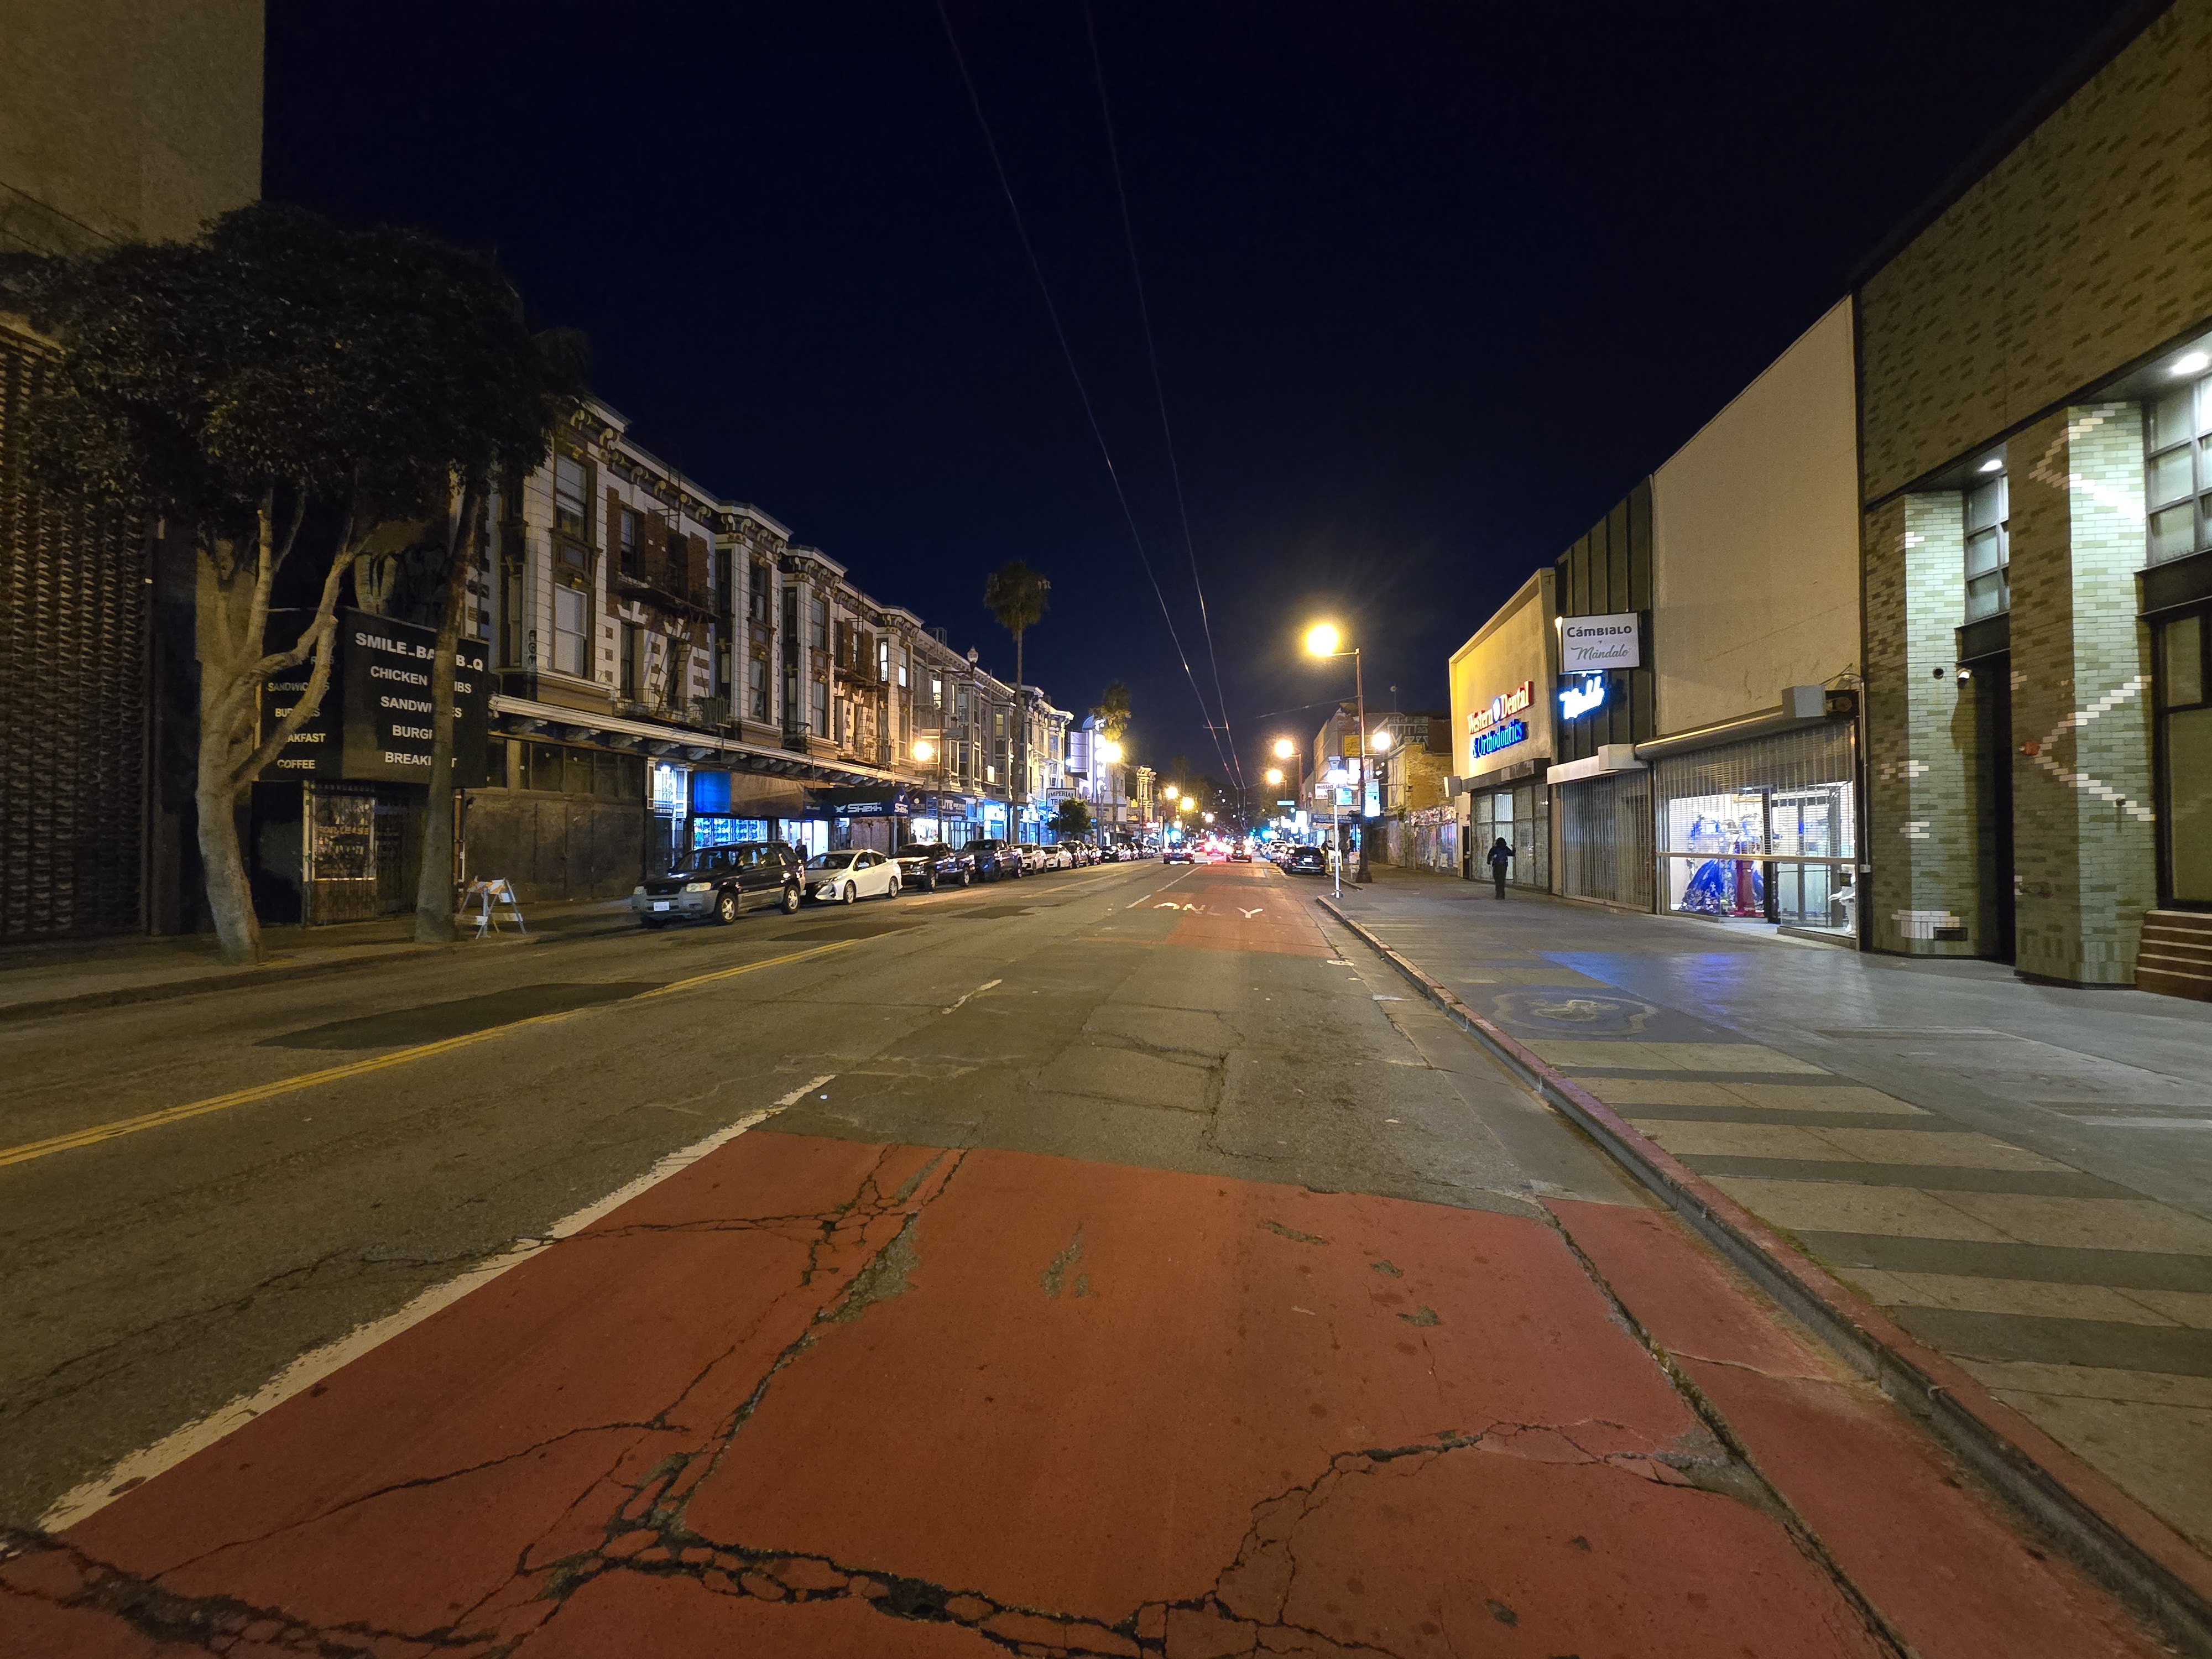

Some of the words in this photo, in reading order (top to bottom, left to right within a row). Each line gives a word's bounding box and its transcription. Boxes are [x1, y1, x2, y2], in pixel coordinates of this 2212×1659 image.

[371, 666, 427, 686] CHICKEN
[1467, 709, 1494, 734] Western
[1500, 681, 1532, 719] Dental
[1478, 719, 1523, 755] Orthodontics
[277, 759, 316, 769] COFFEE
